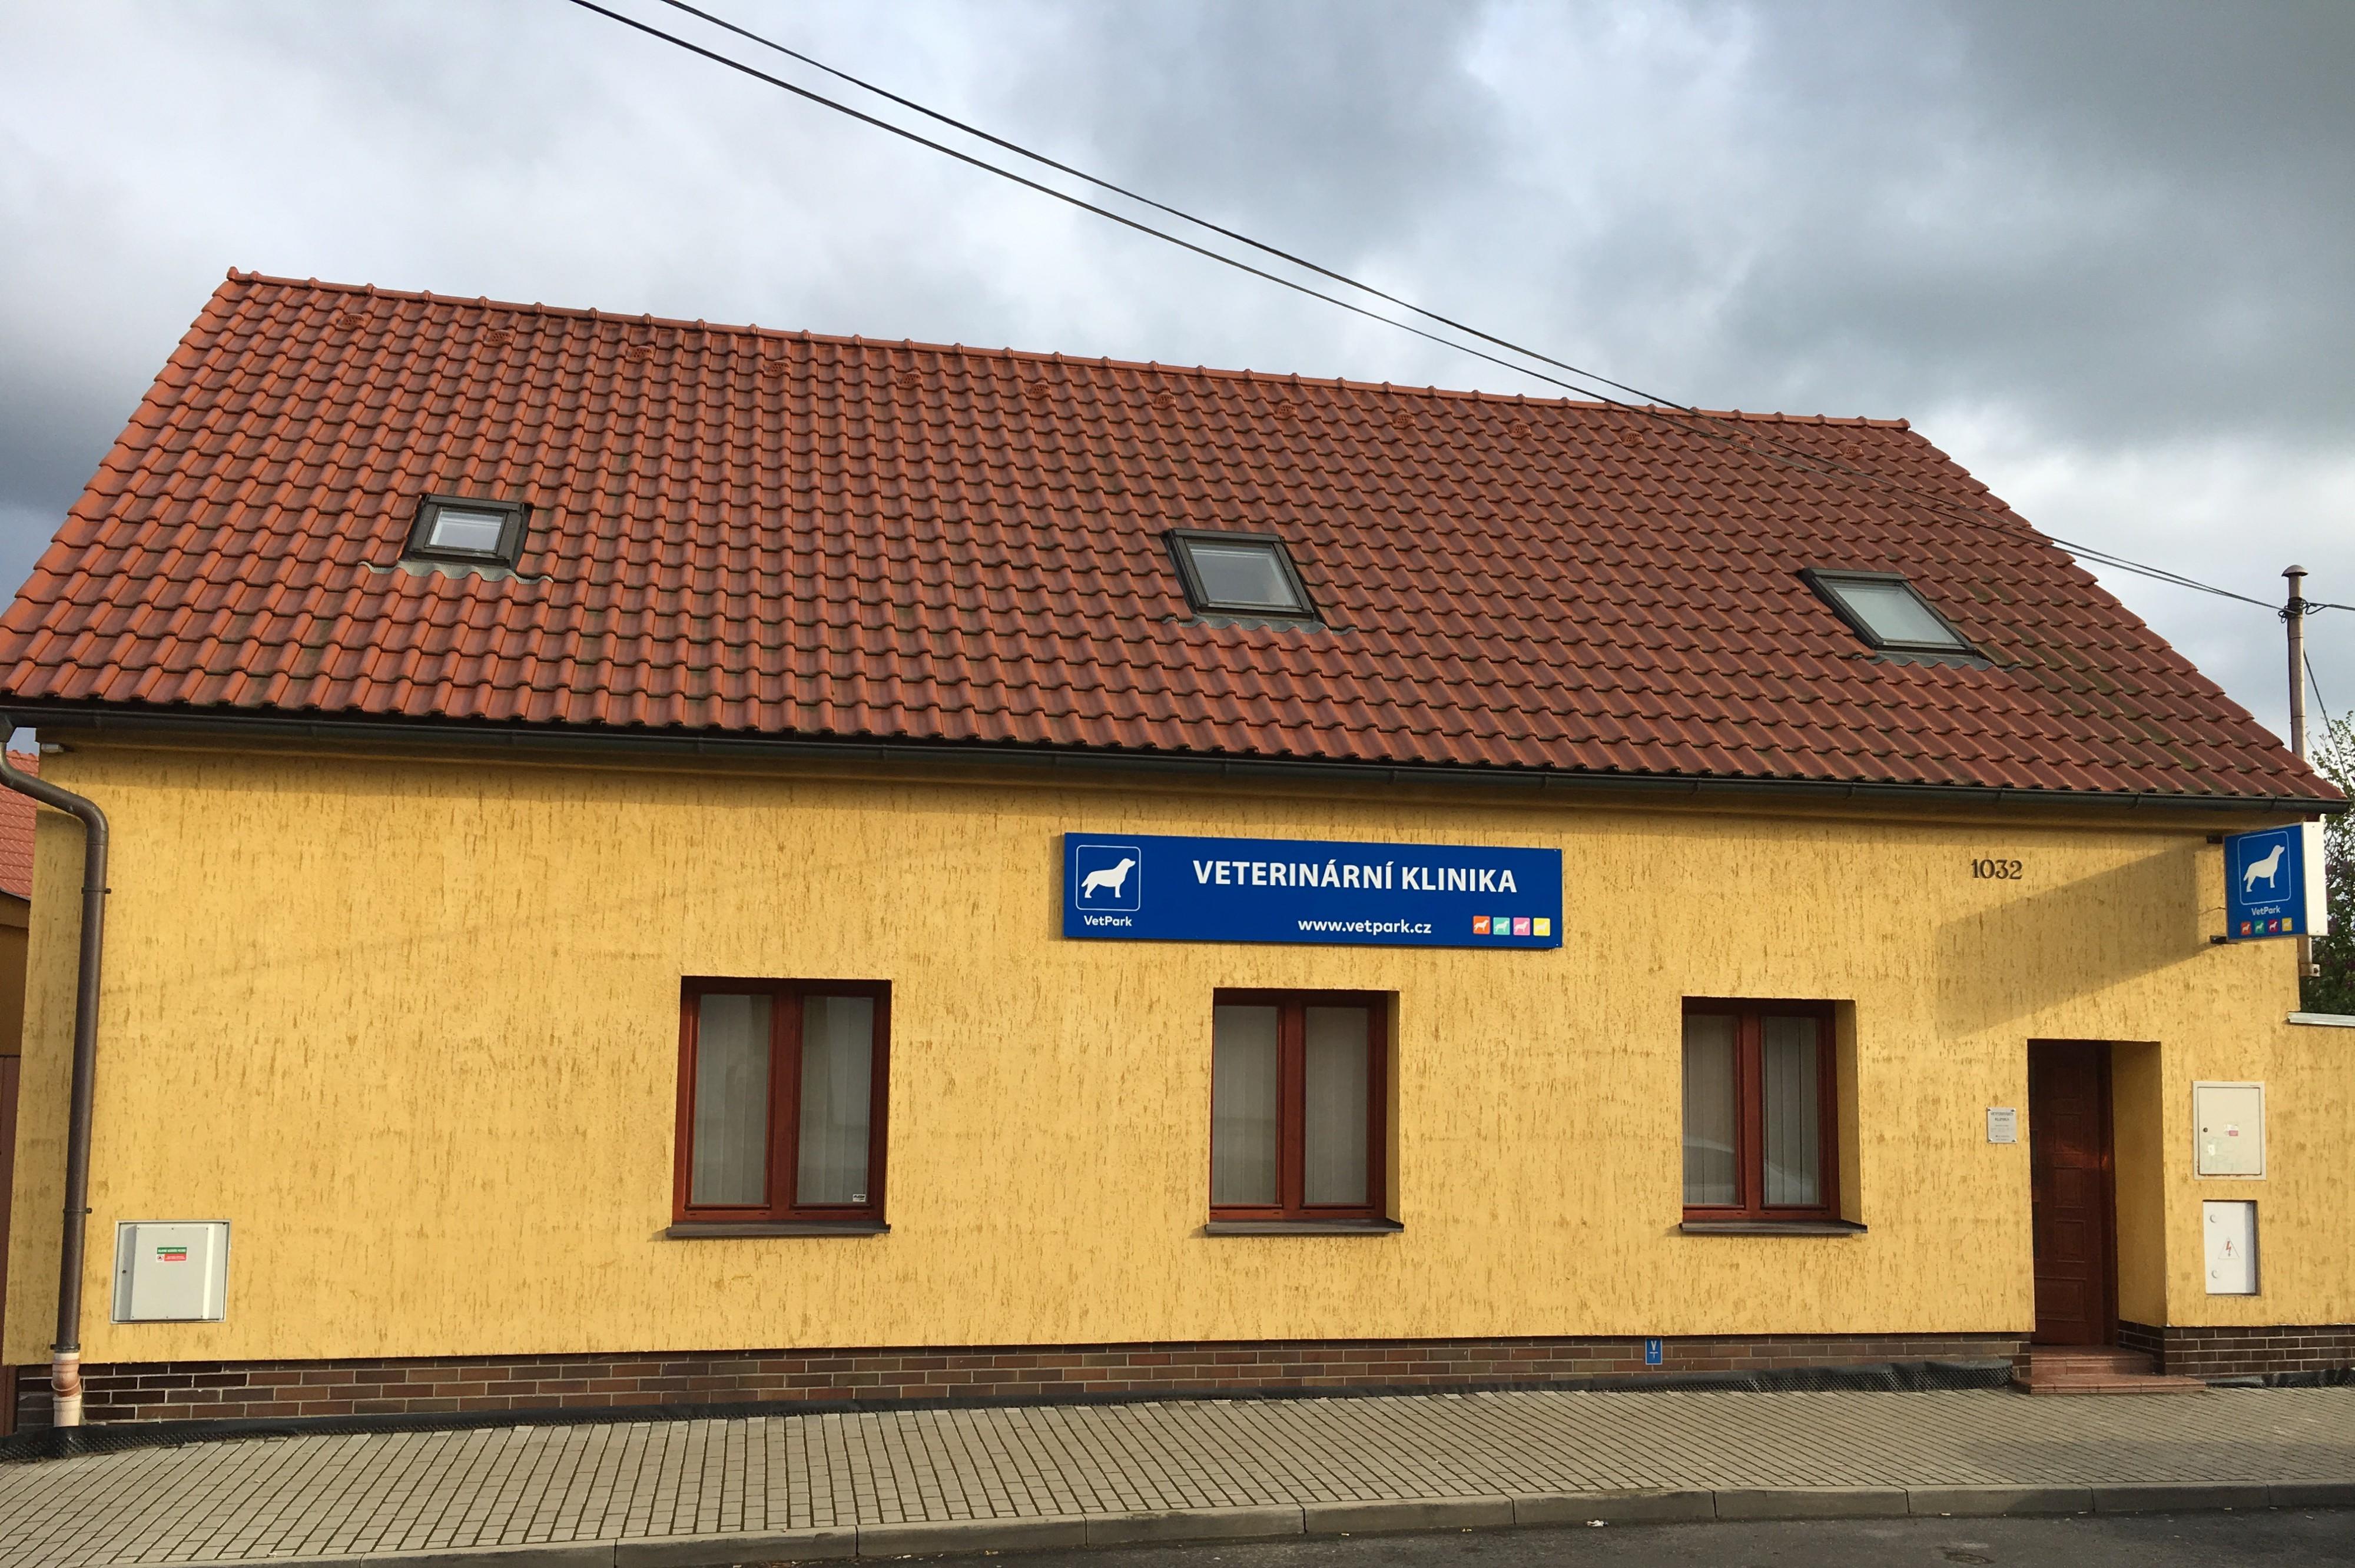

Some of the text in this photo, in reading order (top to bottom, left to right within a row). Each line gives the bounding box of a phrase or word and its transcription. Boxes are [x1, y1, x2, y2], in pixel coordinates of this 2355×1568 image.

[1192, 859, 1517, 893] VETERINÁRNÍ KLINIKA
[1971, 859, 2023, 880] 1032
[2251, 905, 2281, 915] VetPark
[1083, 915, 1133, 927] VetPark
[1297, 918, 1432, 936] www.vetpark.cz
